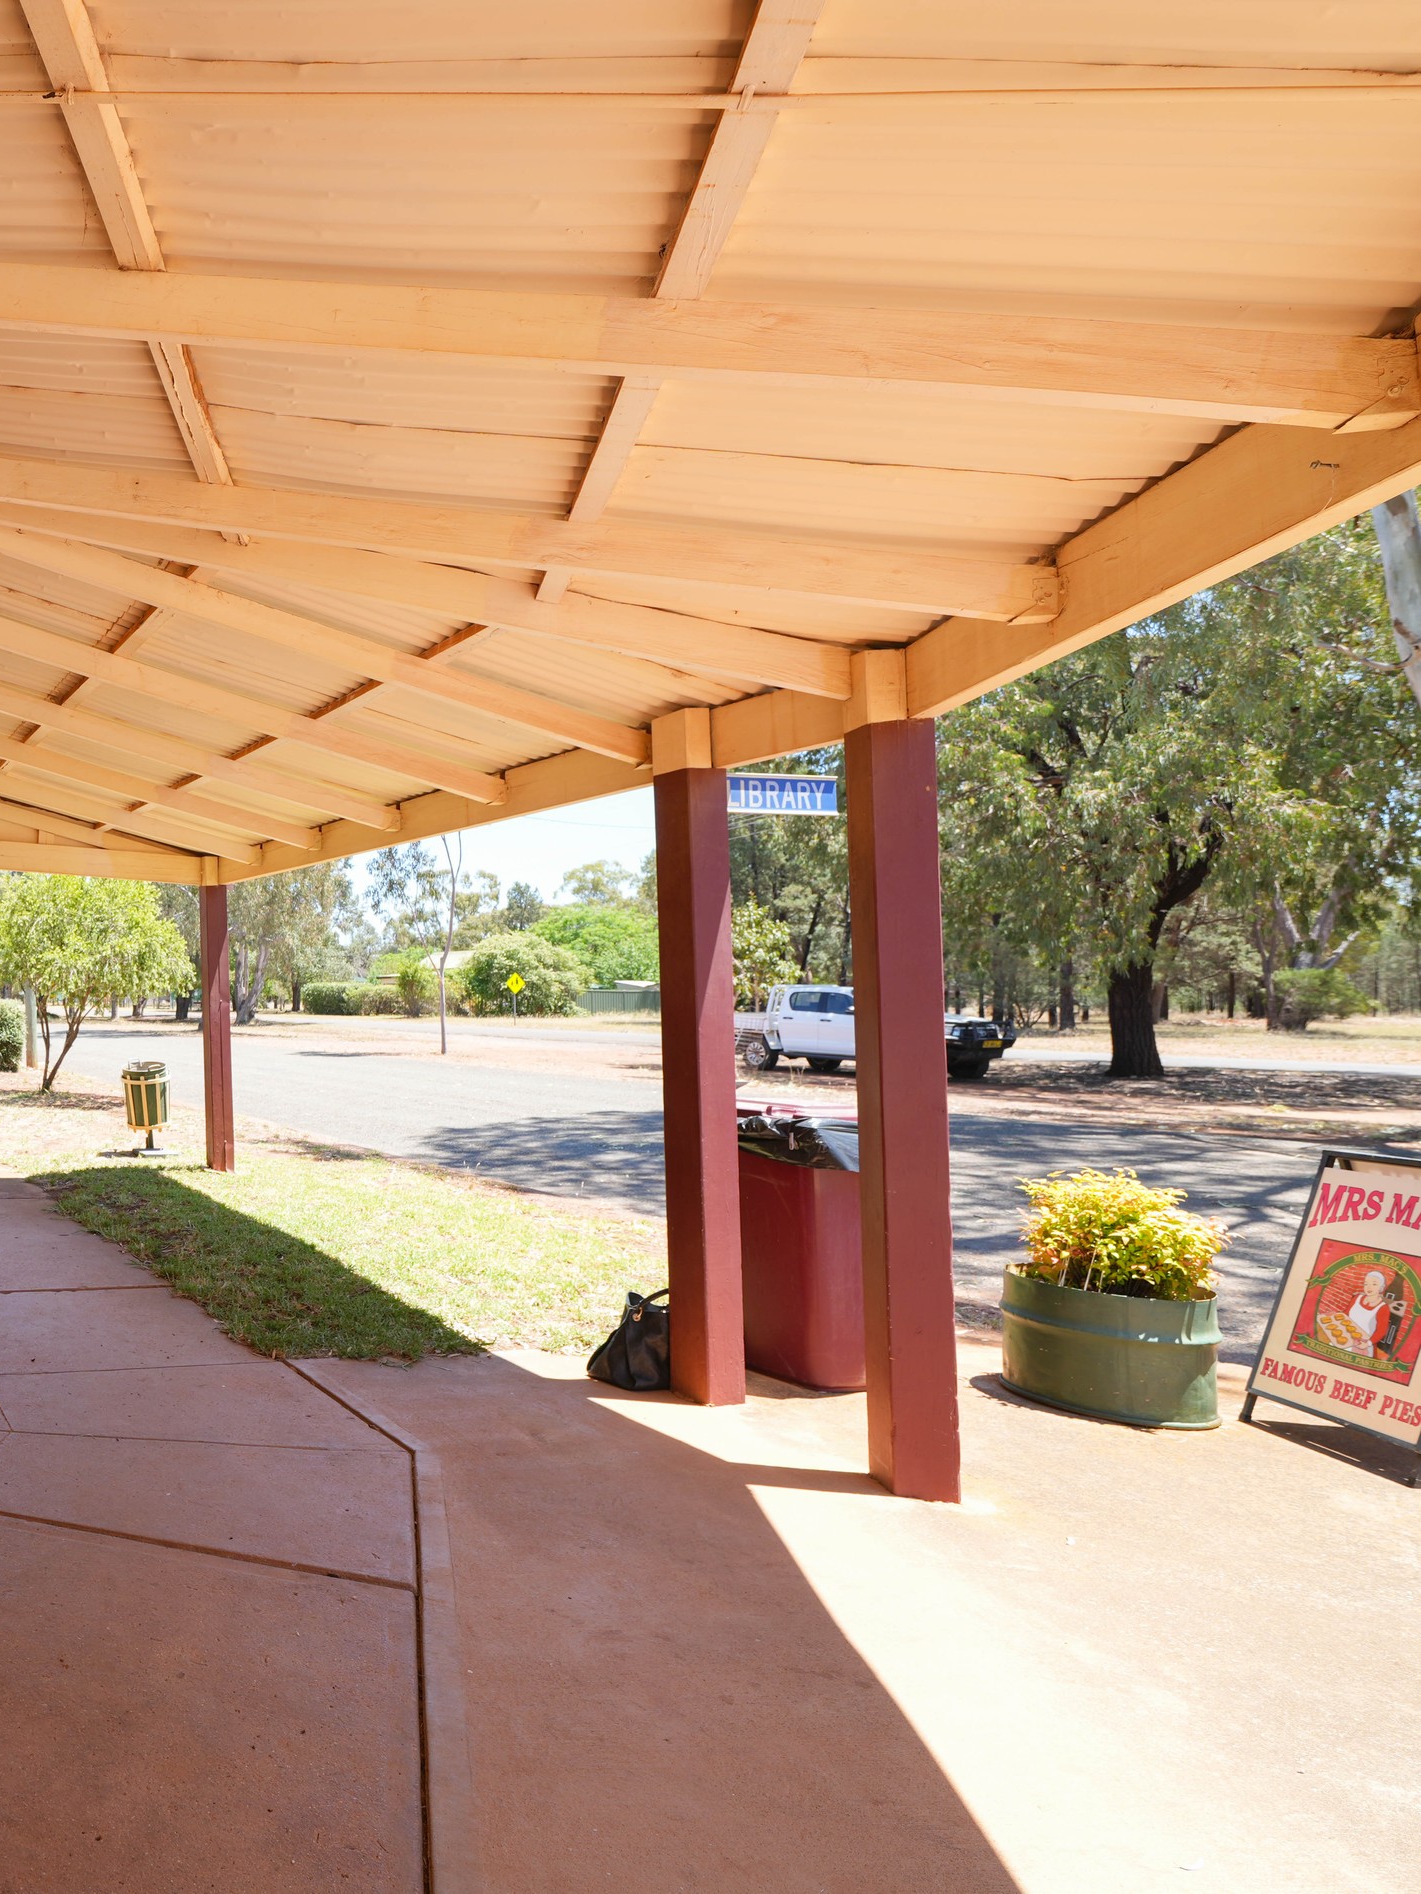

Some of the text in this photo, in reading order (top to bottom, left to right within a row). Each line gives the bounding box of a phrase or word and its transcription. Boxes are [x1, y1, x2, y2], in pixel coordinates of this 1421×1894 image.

[727, 779, 826, 810] LIBRARY
[1308, 1181, 1385, 1229] MRS
[1353, 1253, 1408, 1275] MRS. MAC'S
[1306, 1339, 1394, 1370] TRADITIONAL PASTRIES
[1260, 1356, 1421, 1427] FAMOUS BEEF PIES
